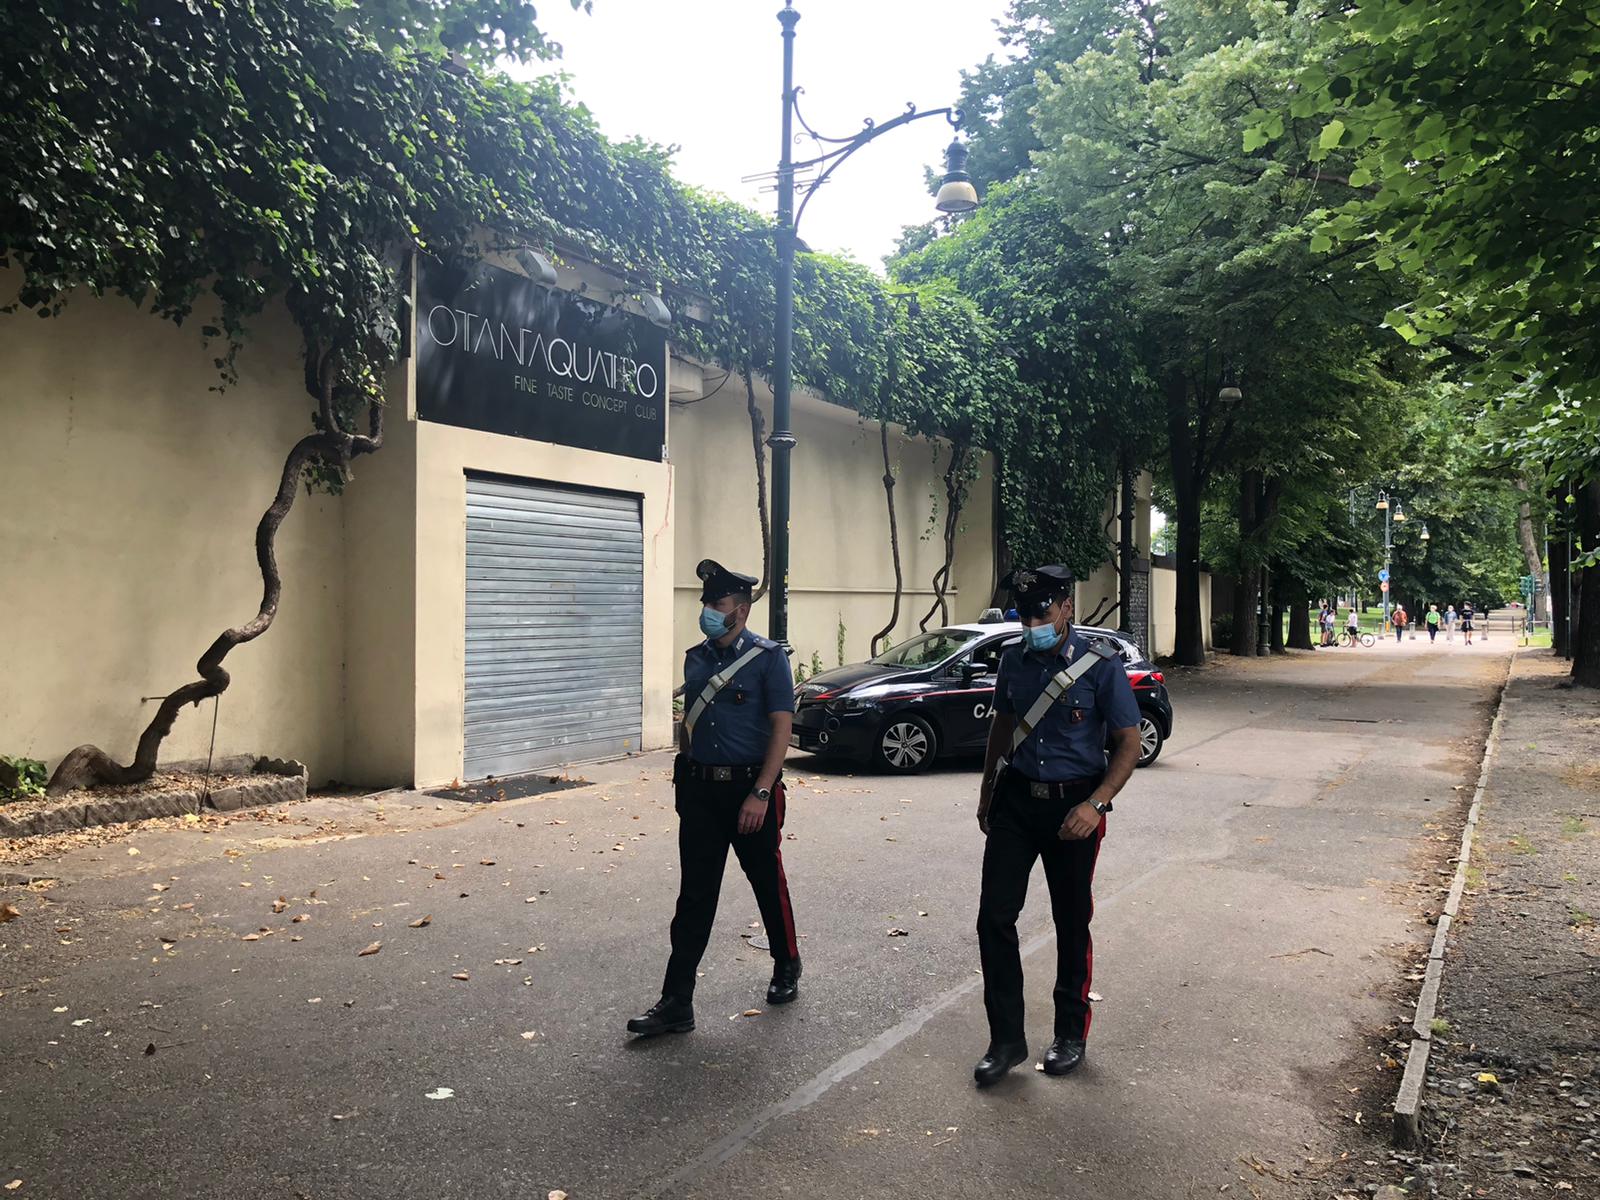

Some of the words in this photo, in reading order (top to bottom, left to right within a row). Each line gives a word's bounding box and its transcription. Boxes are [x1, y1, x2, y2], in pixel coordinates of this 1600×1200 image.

[514, 375, 537, 394] FINE
[547, 382, 574, 402] TASTE
[582, 391, 628, 414] CONCEPT
[634, 404, 657, 421] CLUB
